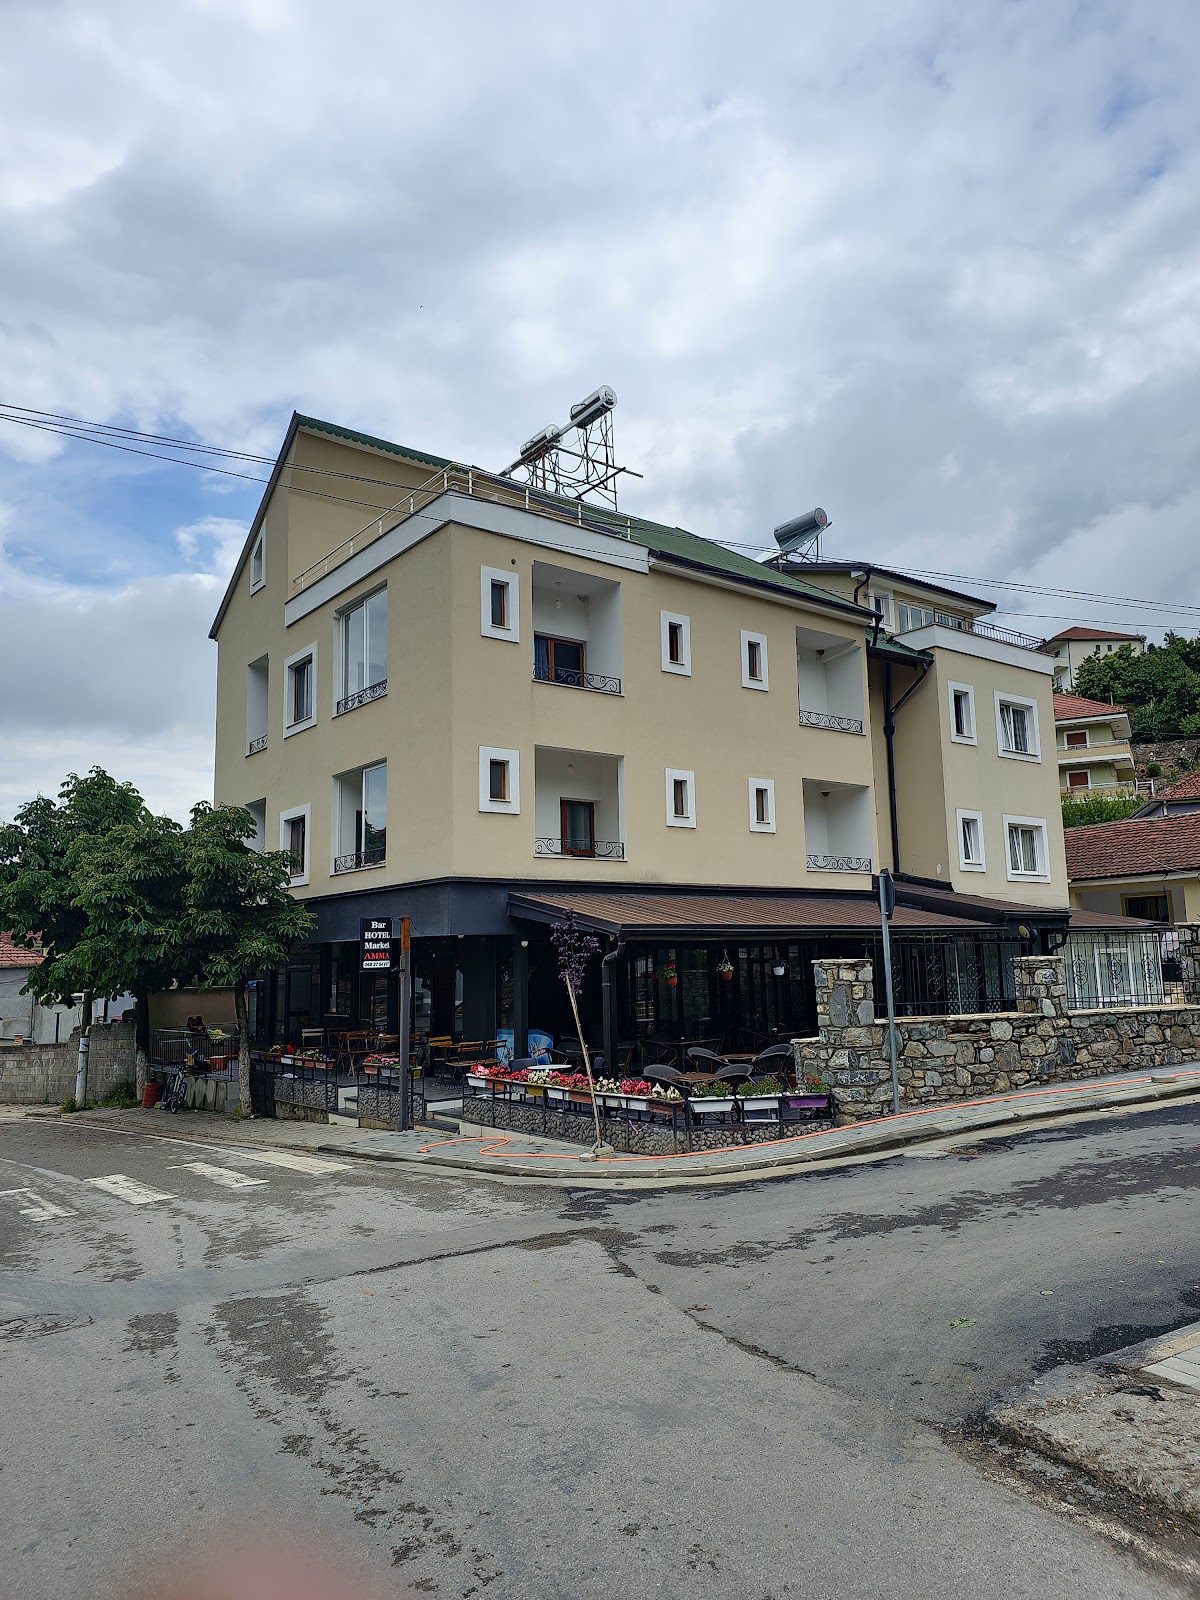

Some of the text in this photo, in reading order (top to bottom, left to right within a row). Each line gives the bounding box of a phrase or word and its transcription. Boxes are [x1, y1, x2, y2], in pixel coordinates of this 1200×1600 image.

[371, 921, 386, 929] Bar
[364, 931, 390, 939] HOTEL
[364, 952, 390, 960] AMMA
